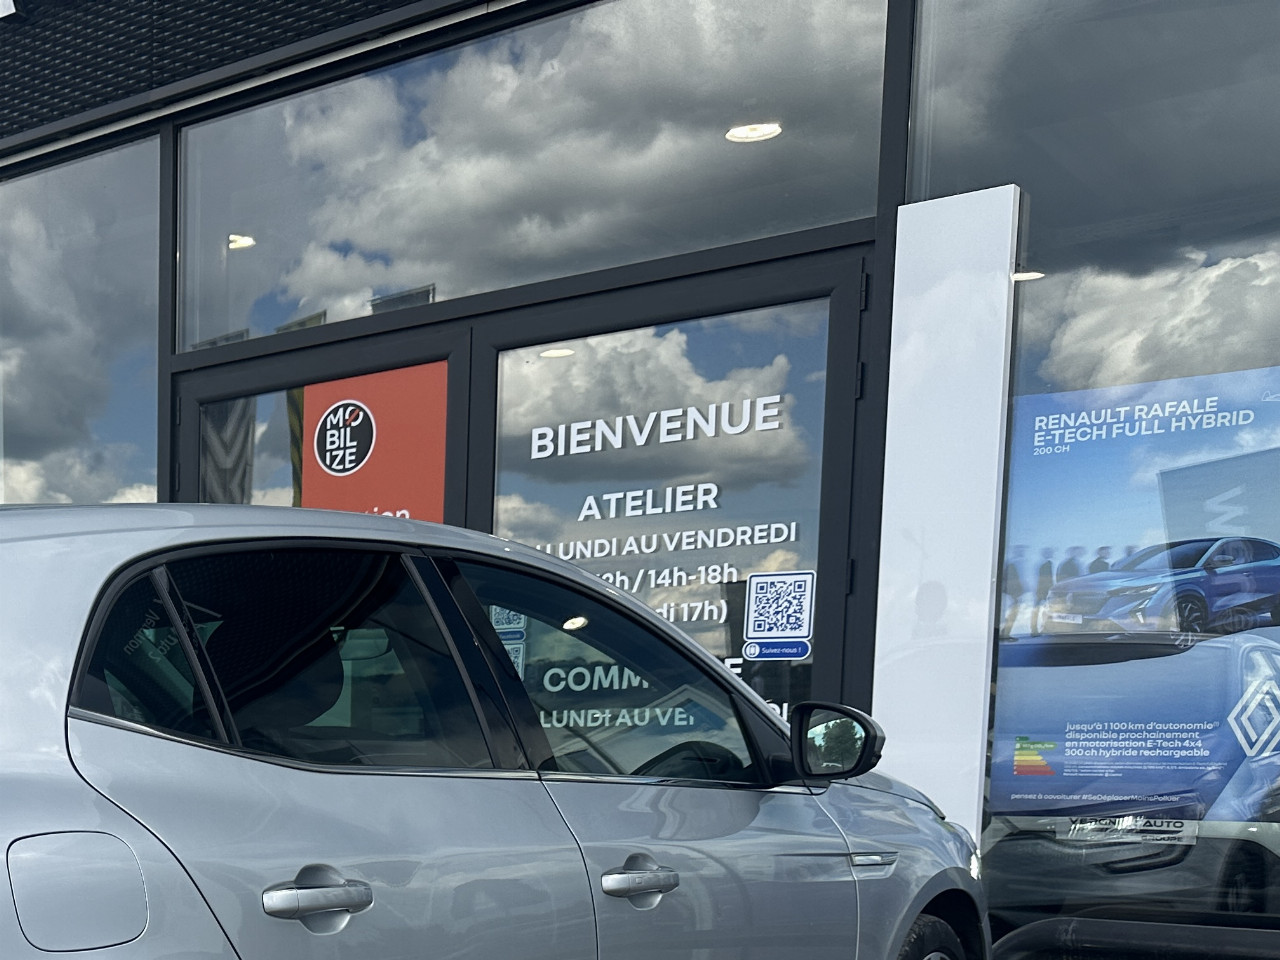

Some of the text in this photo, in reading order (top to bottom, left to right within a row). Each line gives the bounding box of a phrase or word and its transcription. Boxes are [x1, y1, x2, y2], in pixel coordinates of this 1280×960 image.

[1035, 396, 1219, 431] RENAULT RAFALE
[531, 394, 781, 460] BIENVENUE
[1033, 409, 1255, 446] E-TECH FULL HYBRID
[1033, 444, 1070, 456] 200 CH
[577, 482, 719, 522] ATELIER
[621, 534, 658, 555] AU
[662, 522, 797, 552] VENDREDI
[649, 562, 738, 589] 14h-18h
[680, 599, 728, 623] 17h)
[539, 709, 610, 729] LUNDI
[614, 708, 651, 727] AU
[1128, 721, 1145, 730] km
[1065, 730, 1200, 740] disponible prochainement
[1079, 739, 1146, 748] motorisation
[1146, 739, 1182, 748] E-Tech
[1182, 739, 1202, 748] 4x4
[1064, 748, 1210, 758] 300 ch hybride rechargeable
[1143, 820, 1185, 829] AUTO
